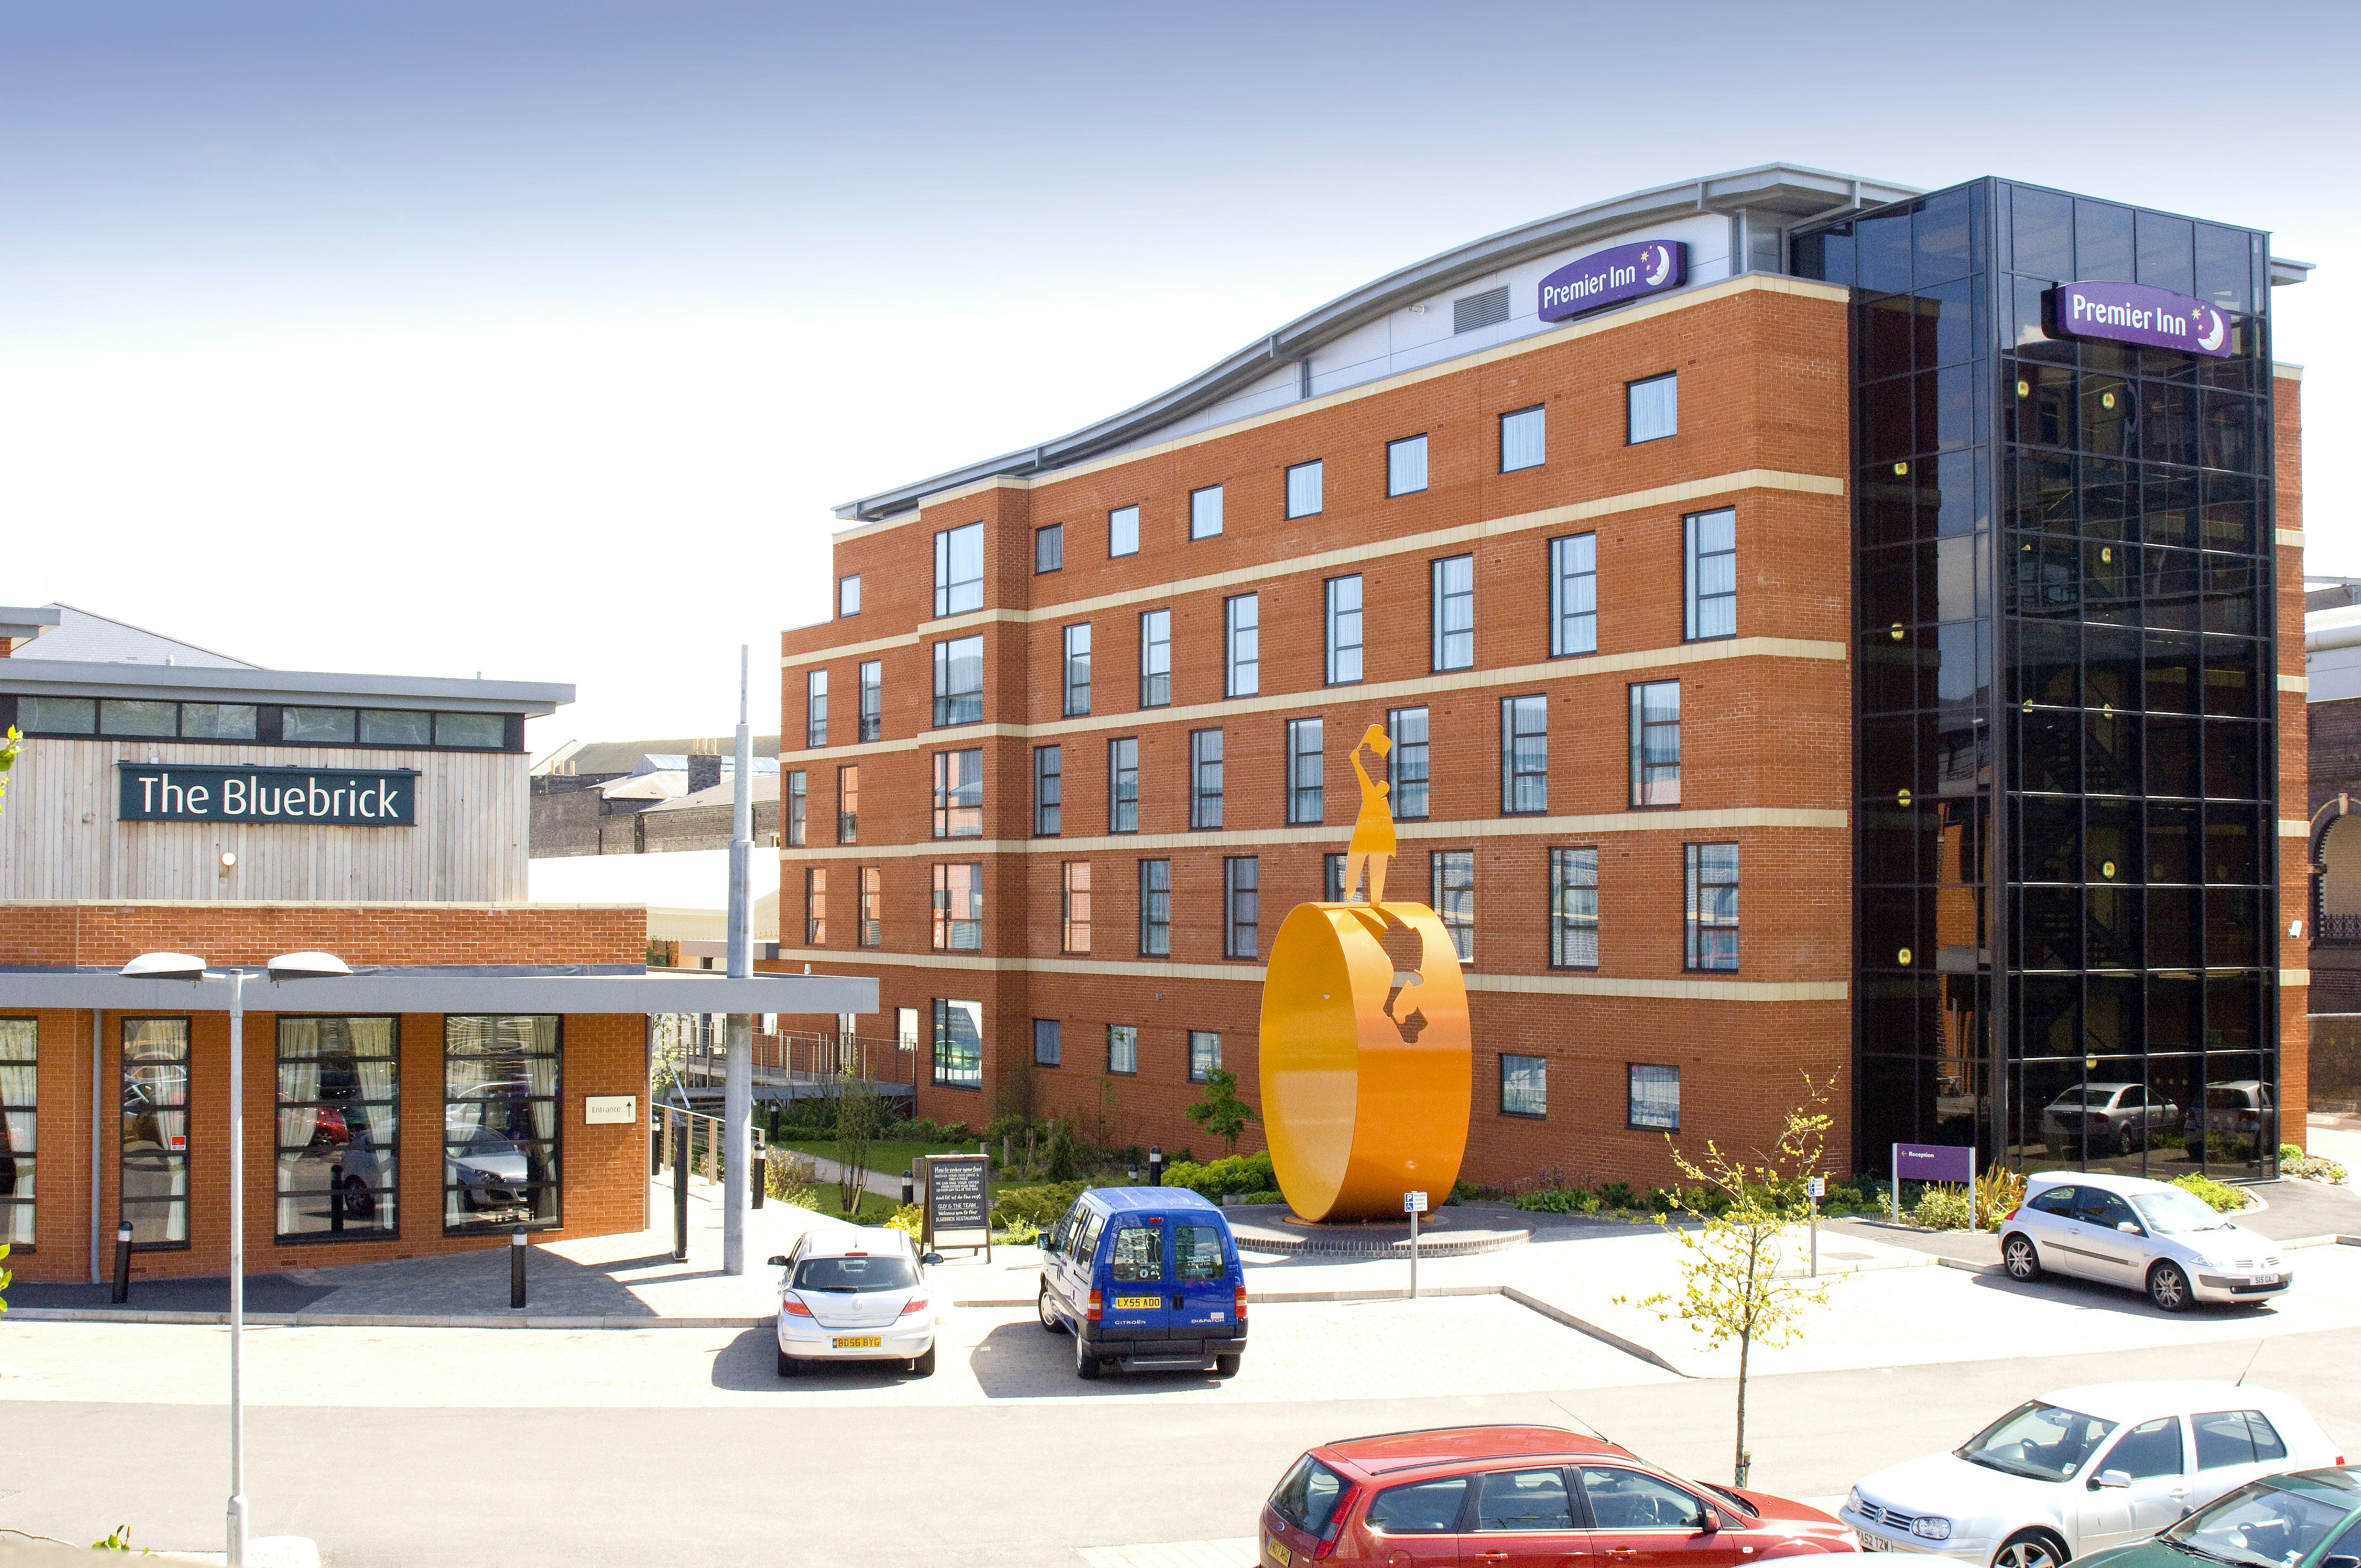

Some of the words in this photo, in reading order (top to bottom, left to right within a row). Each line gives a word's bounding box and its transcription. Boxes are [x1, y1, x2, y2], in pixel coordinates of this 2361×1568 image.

[1544, 274, 1607, 309] Premier
[1610, 266, 1635, 288] Inn
[2073, 294, 2153, 330] Premier
[2157, 307, 2186, 336] Inn
[138, 773, 209, 814] The
[224, 775, 399, 818] Bluebrick
[1118, 1298, 1140, 1307] LX55
[863, 1338, 880, 1347] BYG
[1875, 1537, 1889, 1552] TZN
